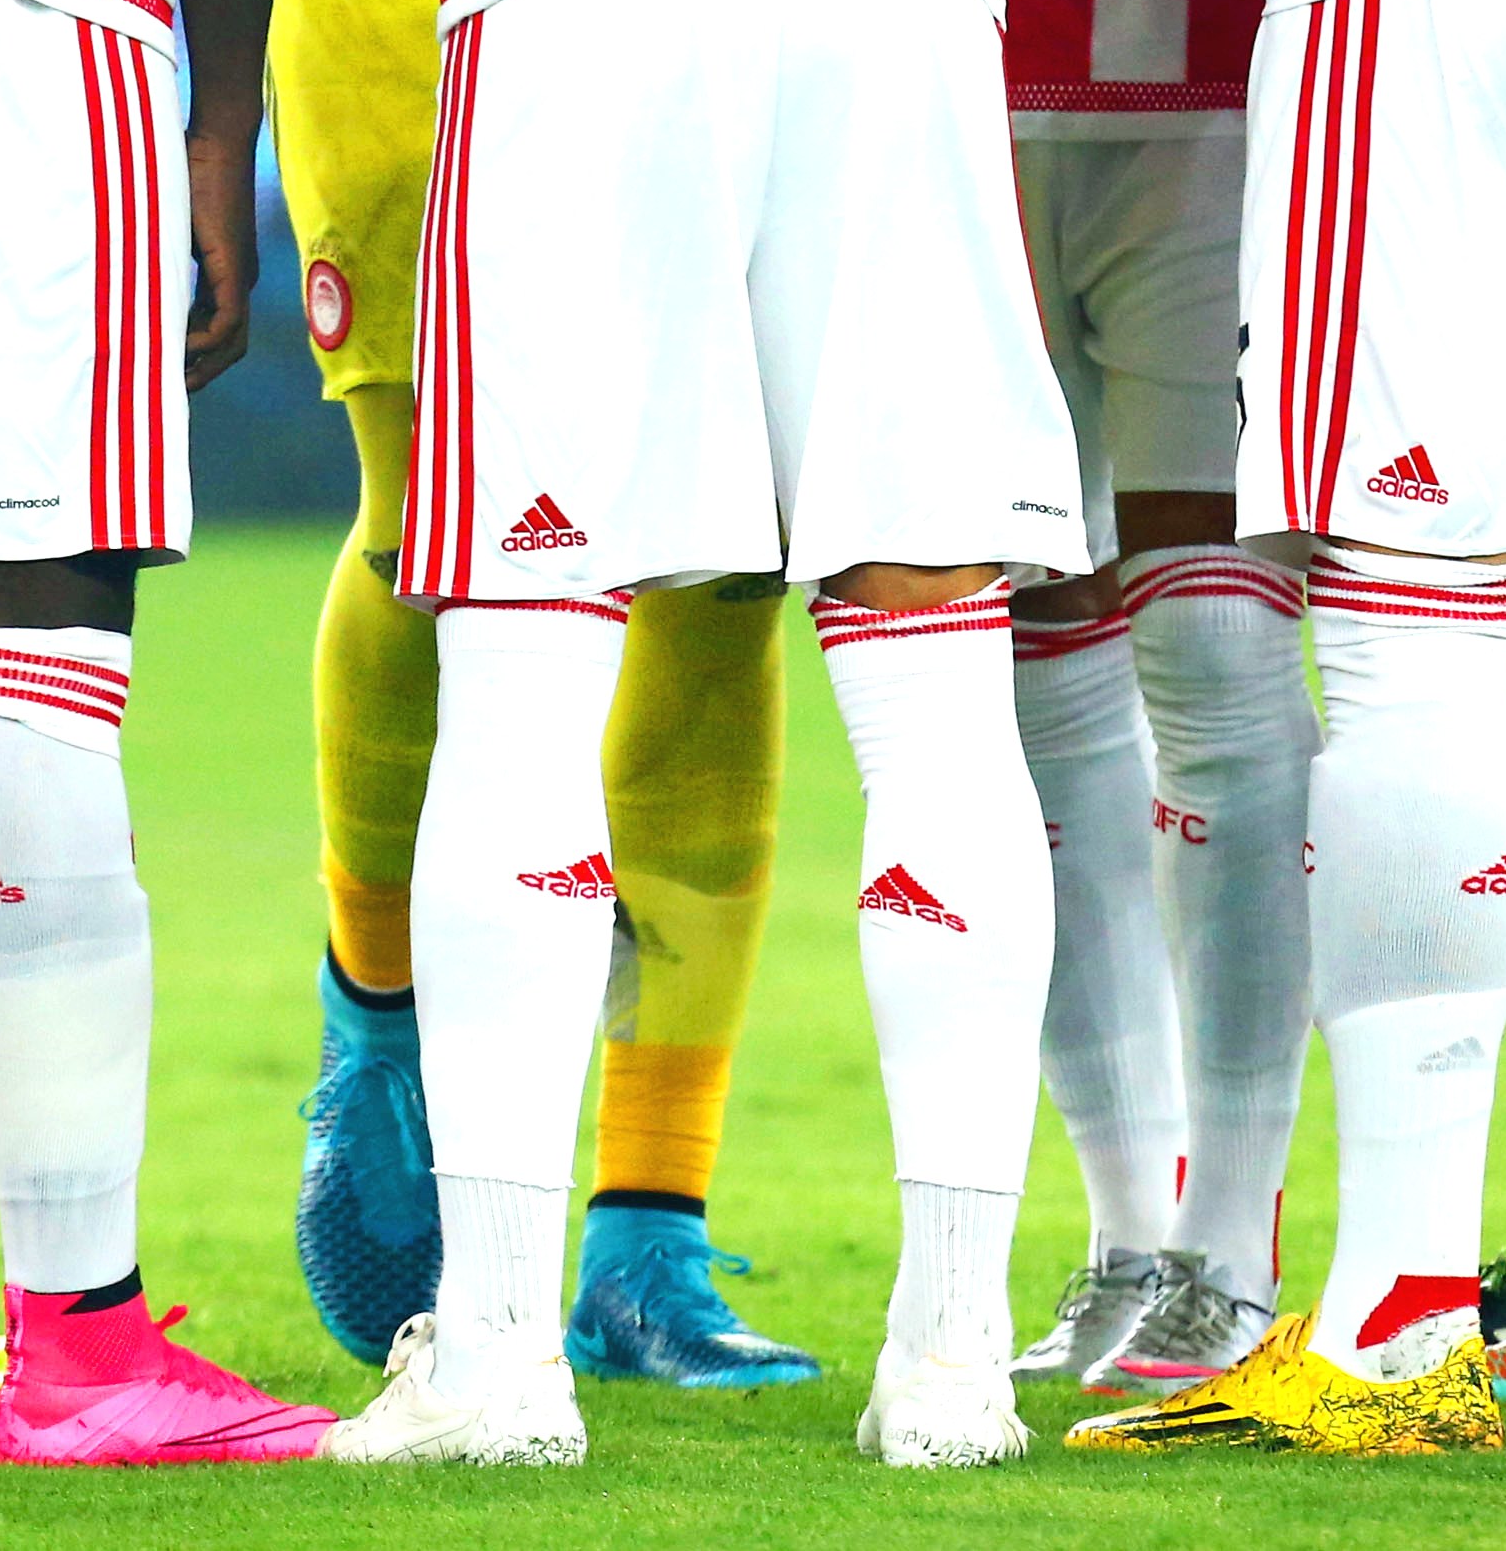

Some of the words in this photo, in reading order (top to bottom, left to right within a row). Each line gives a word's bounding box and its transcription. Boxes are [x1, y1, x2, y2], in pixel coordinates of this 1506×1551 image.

[1366, 477, 1450, 505] adidas
[1012, 499, 1068, 518] climacool
[501, 529, 588, 552] adidas
[516, 873, 619, 899] adida
